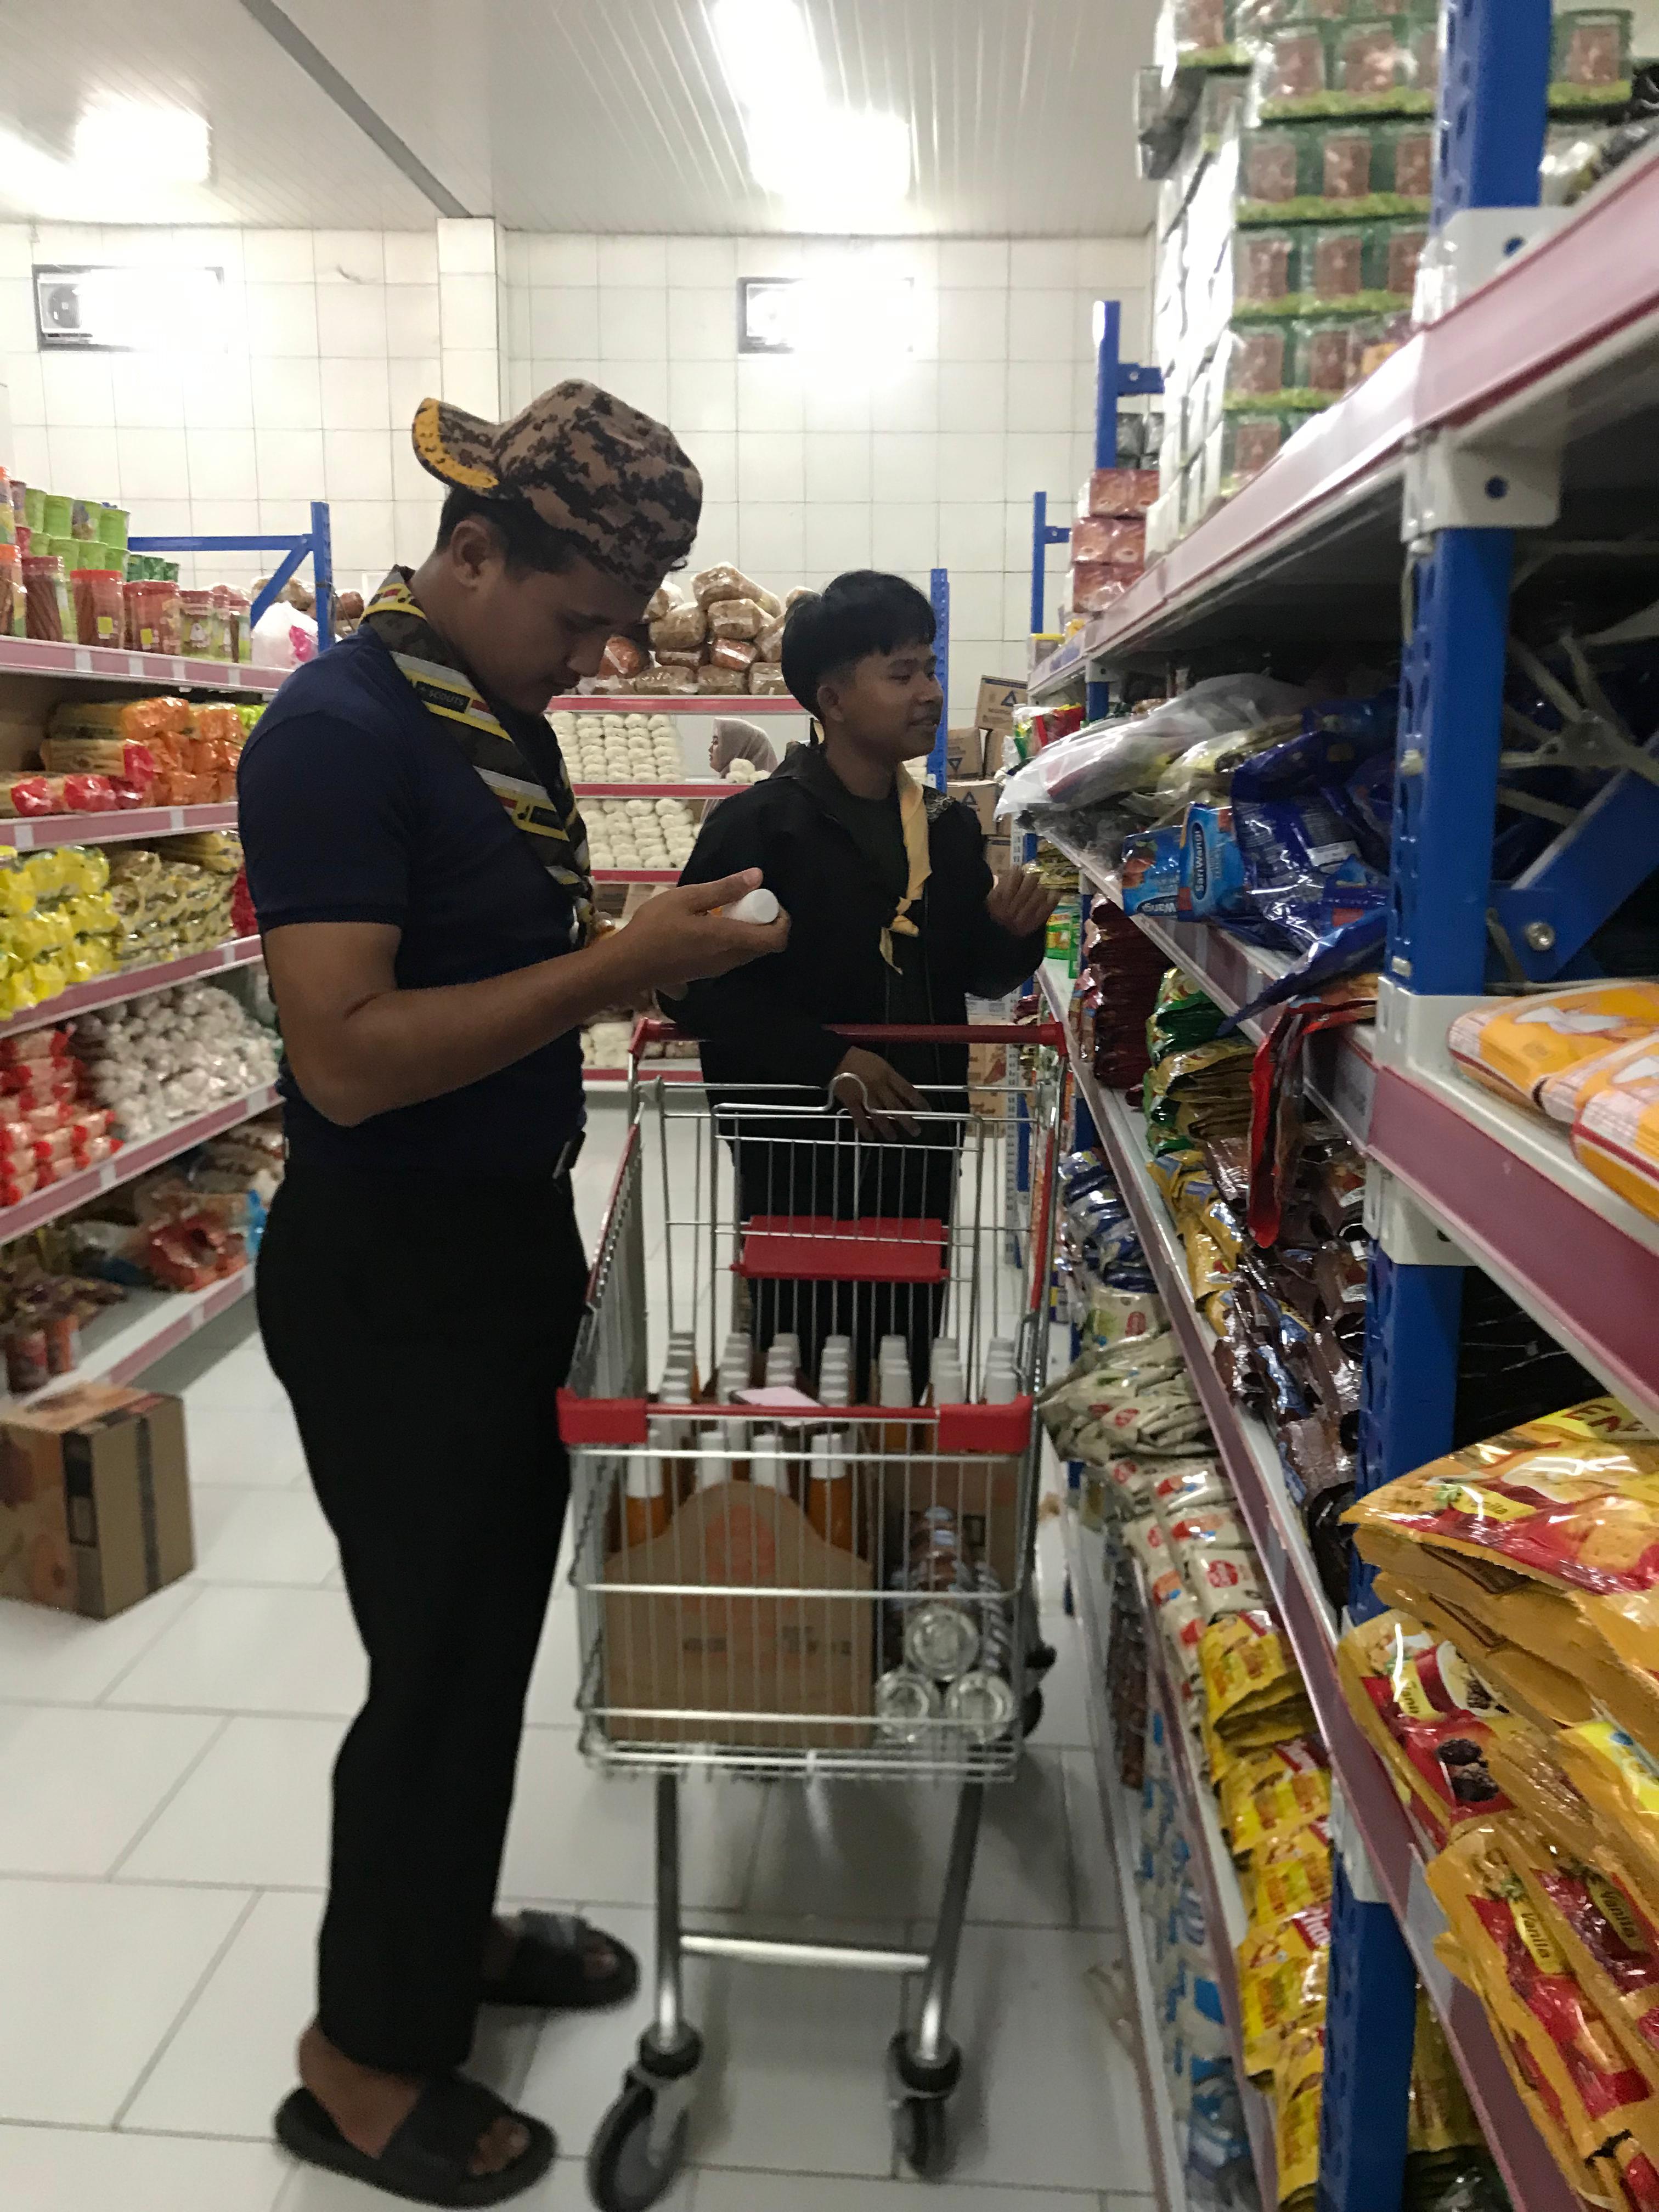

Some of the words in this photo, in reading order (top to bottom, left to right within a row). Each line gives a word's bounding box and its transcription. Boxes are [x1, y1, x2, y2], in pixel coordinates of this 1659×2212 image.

[428, 690, 465, 706] SCOUTS
[1521, 1913, 1550, 1957] Vanilla
[1600, 1891, 1637, 1938] Vanilla
